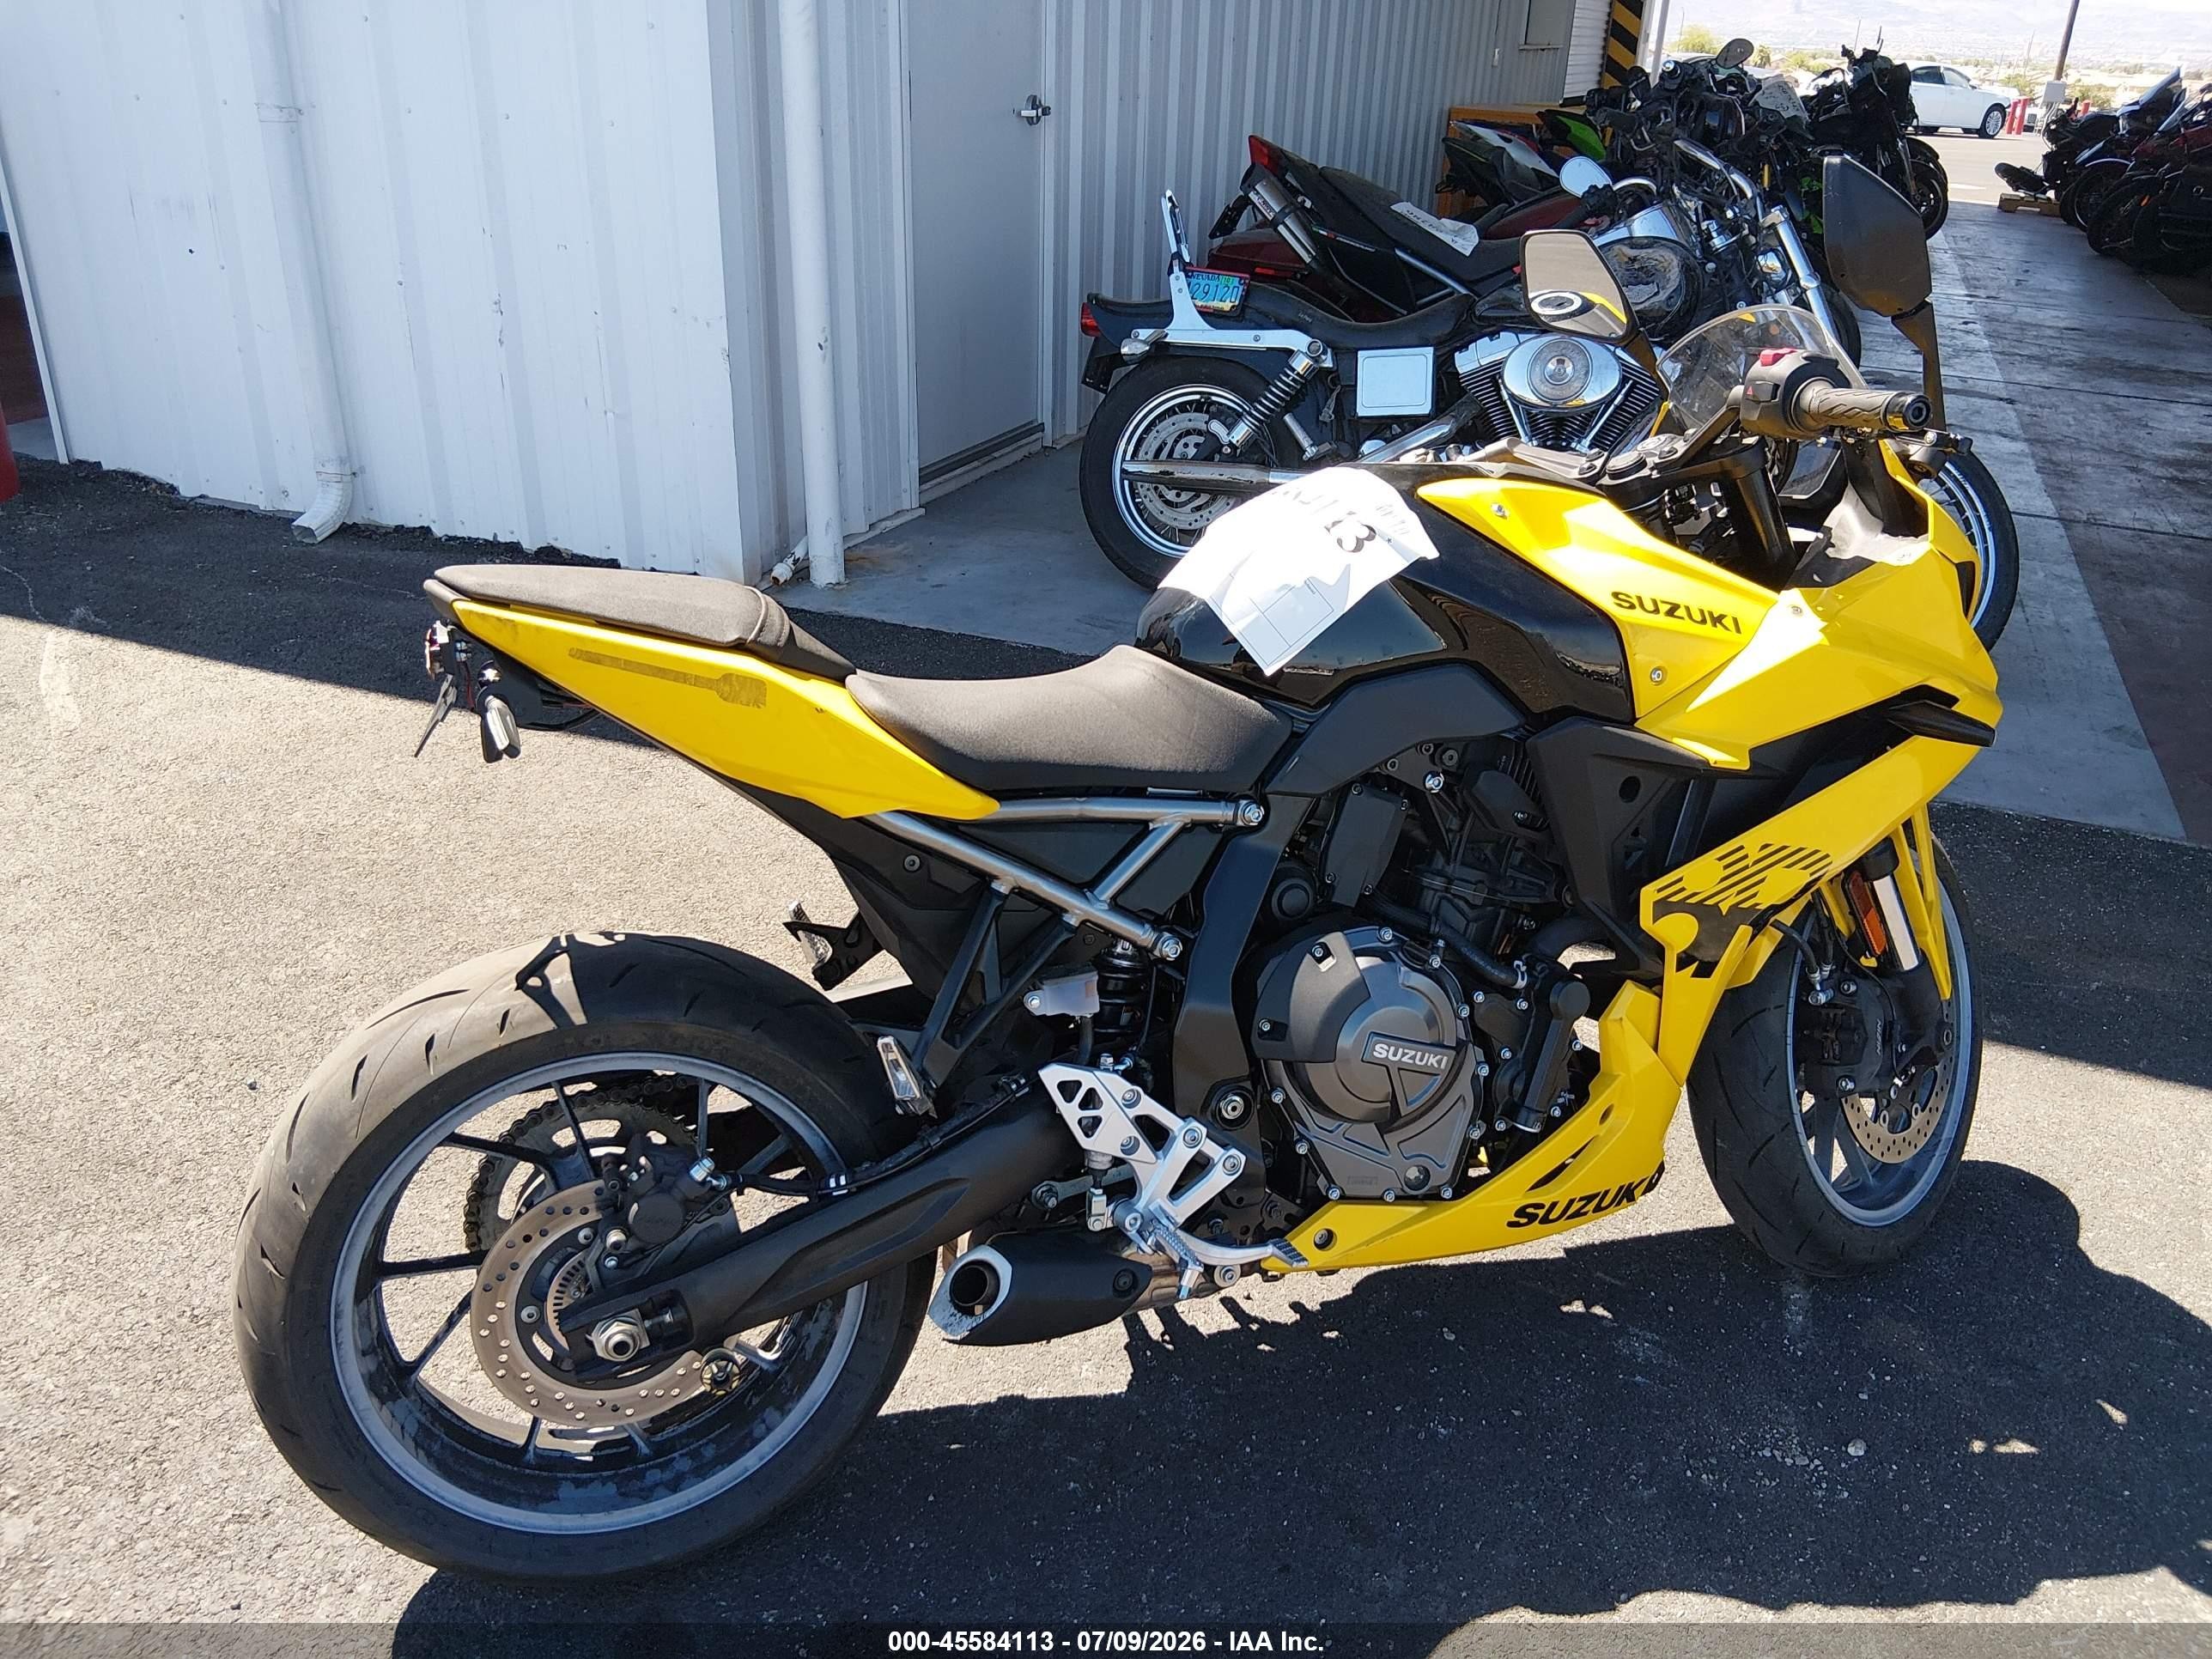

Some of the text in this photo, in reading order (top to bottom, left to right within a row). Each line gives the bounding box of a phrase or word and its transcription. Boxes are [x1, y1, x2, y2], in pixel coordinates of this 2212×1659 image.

[1188, 280, 1240, 303] 29120
[1192, 273, 1220, 283] NEVADA
[1611, 591, 1742, 635] SUZUKI
[1373, 1042, 1449, 1070] SUZUKI
[1505, 1160, 1666, 1229] SUZUKI
